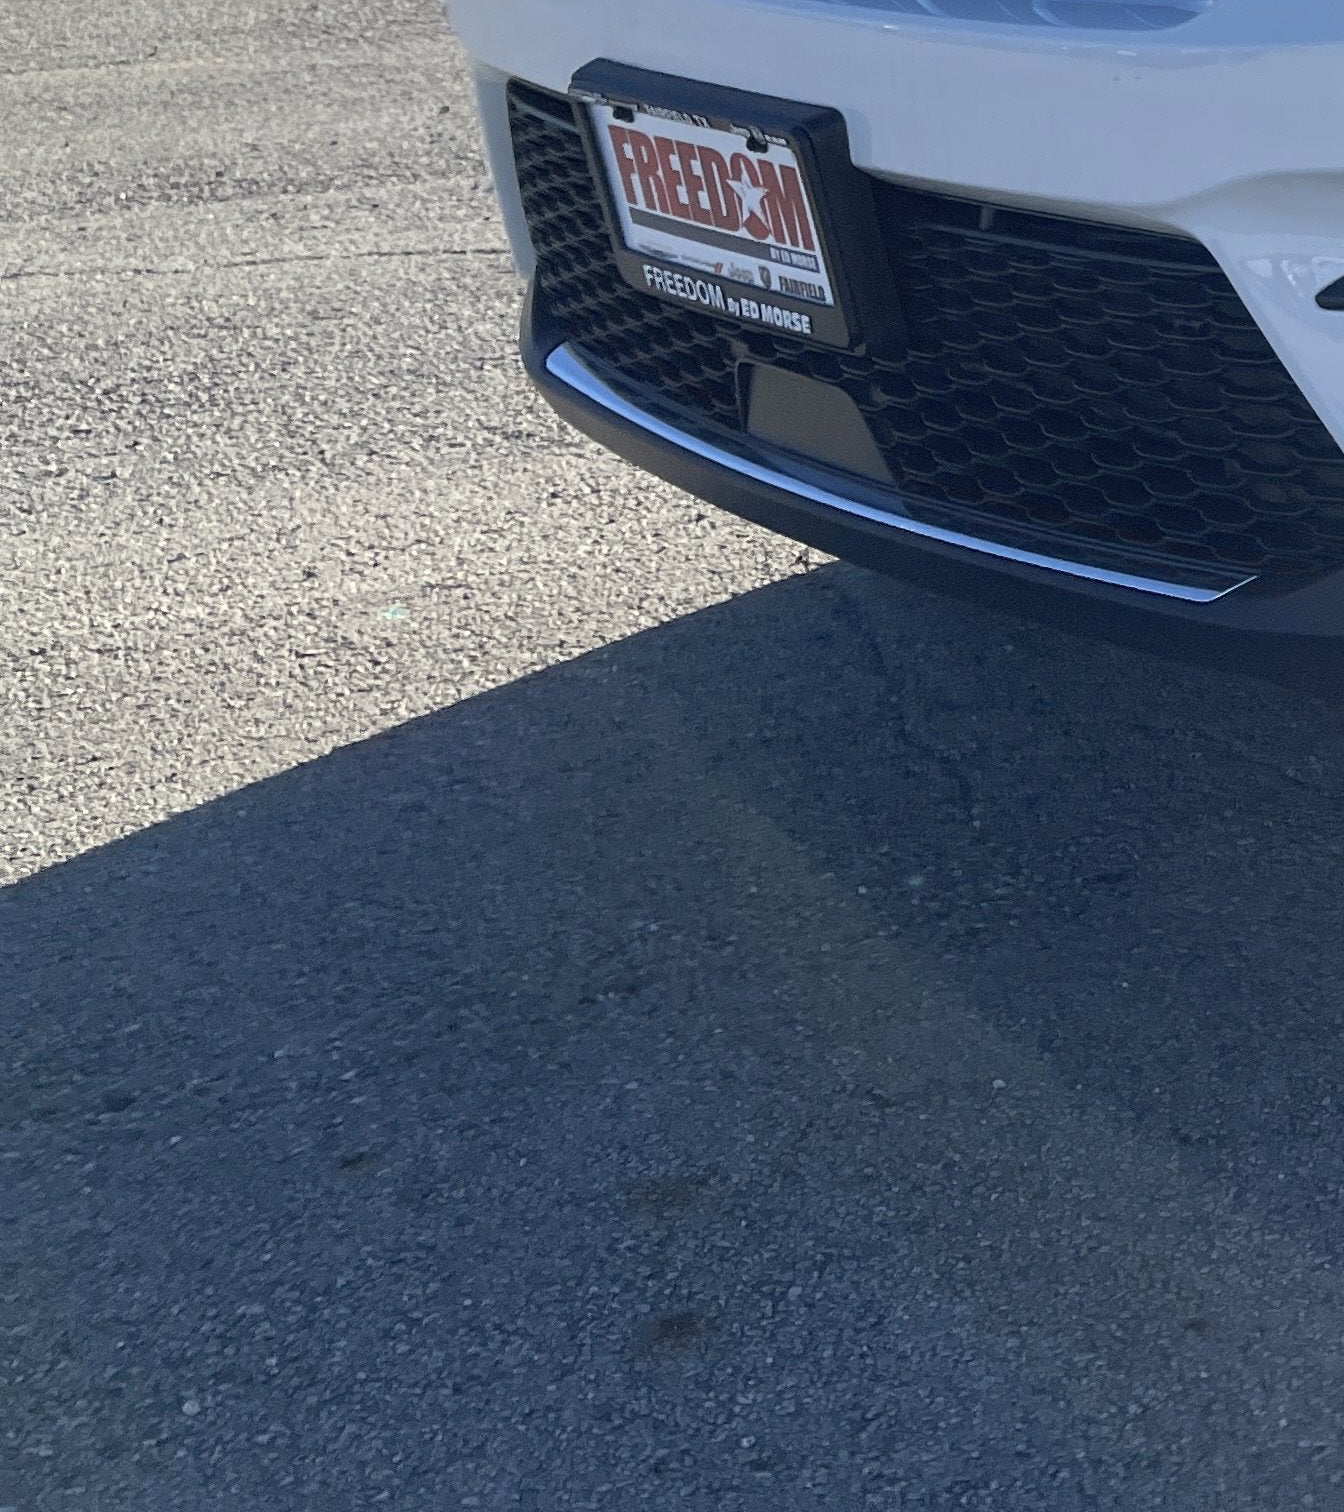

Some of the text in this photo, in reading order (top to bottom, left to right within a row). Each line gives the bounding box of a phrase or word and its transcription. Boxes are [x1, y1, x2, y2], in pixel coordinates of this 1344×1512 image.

[608, 124, 815, 251] FREEDOM
[642, 263, 725, 311] FREEDOM
[740, 297, 760, 320] ED
[760, 303, 812, 335] MORSE
